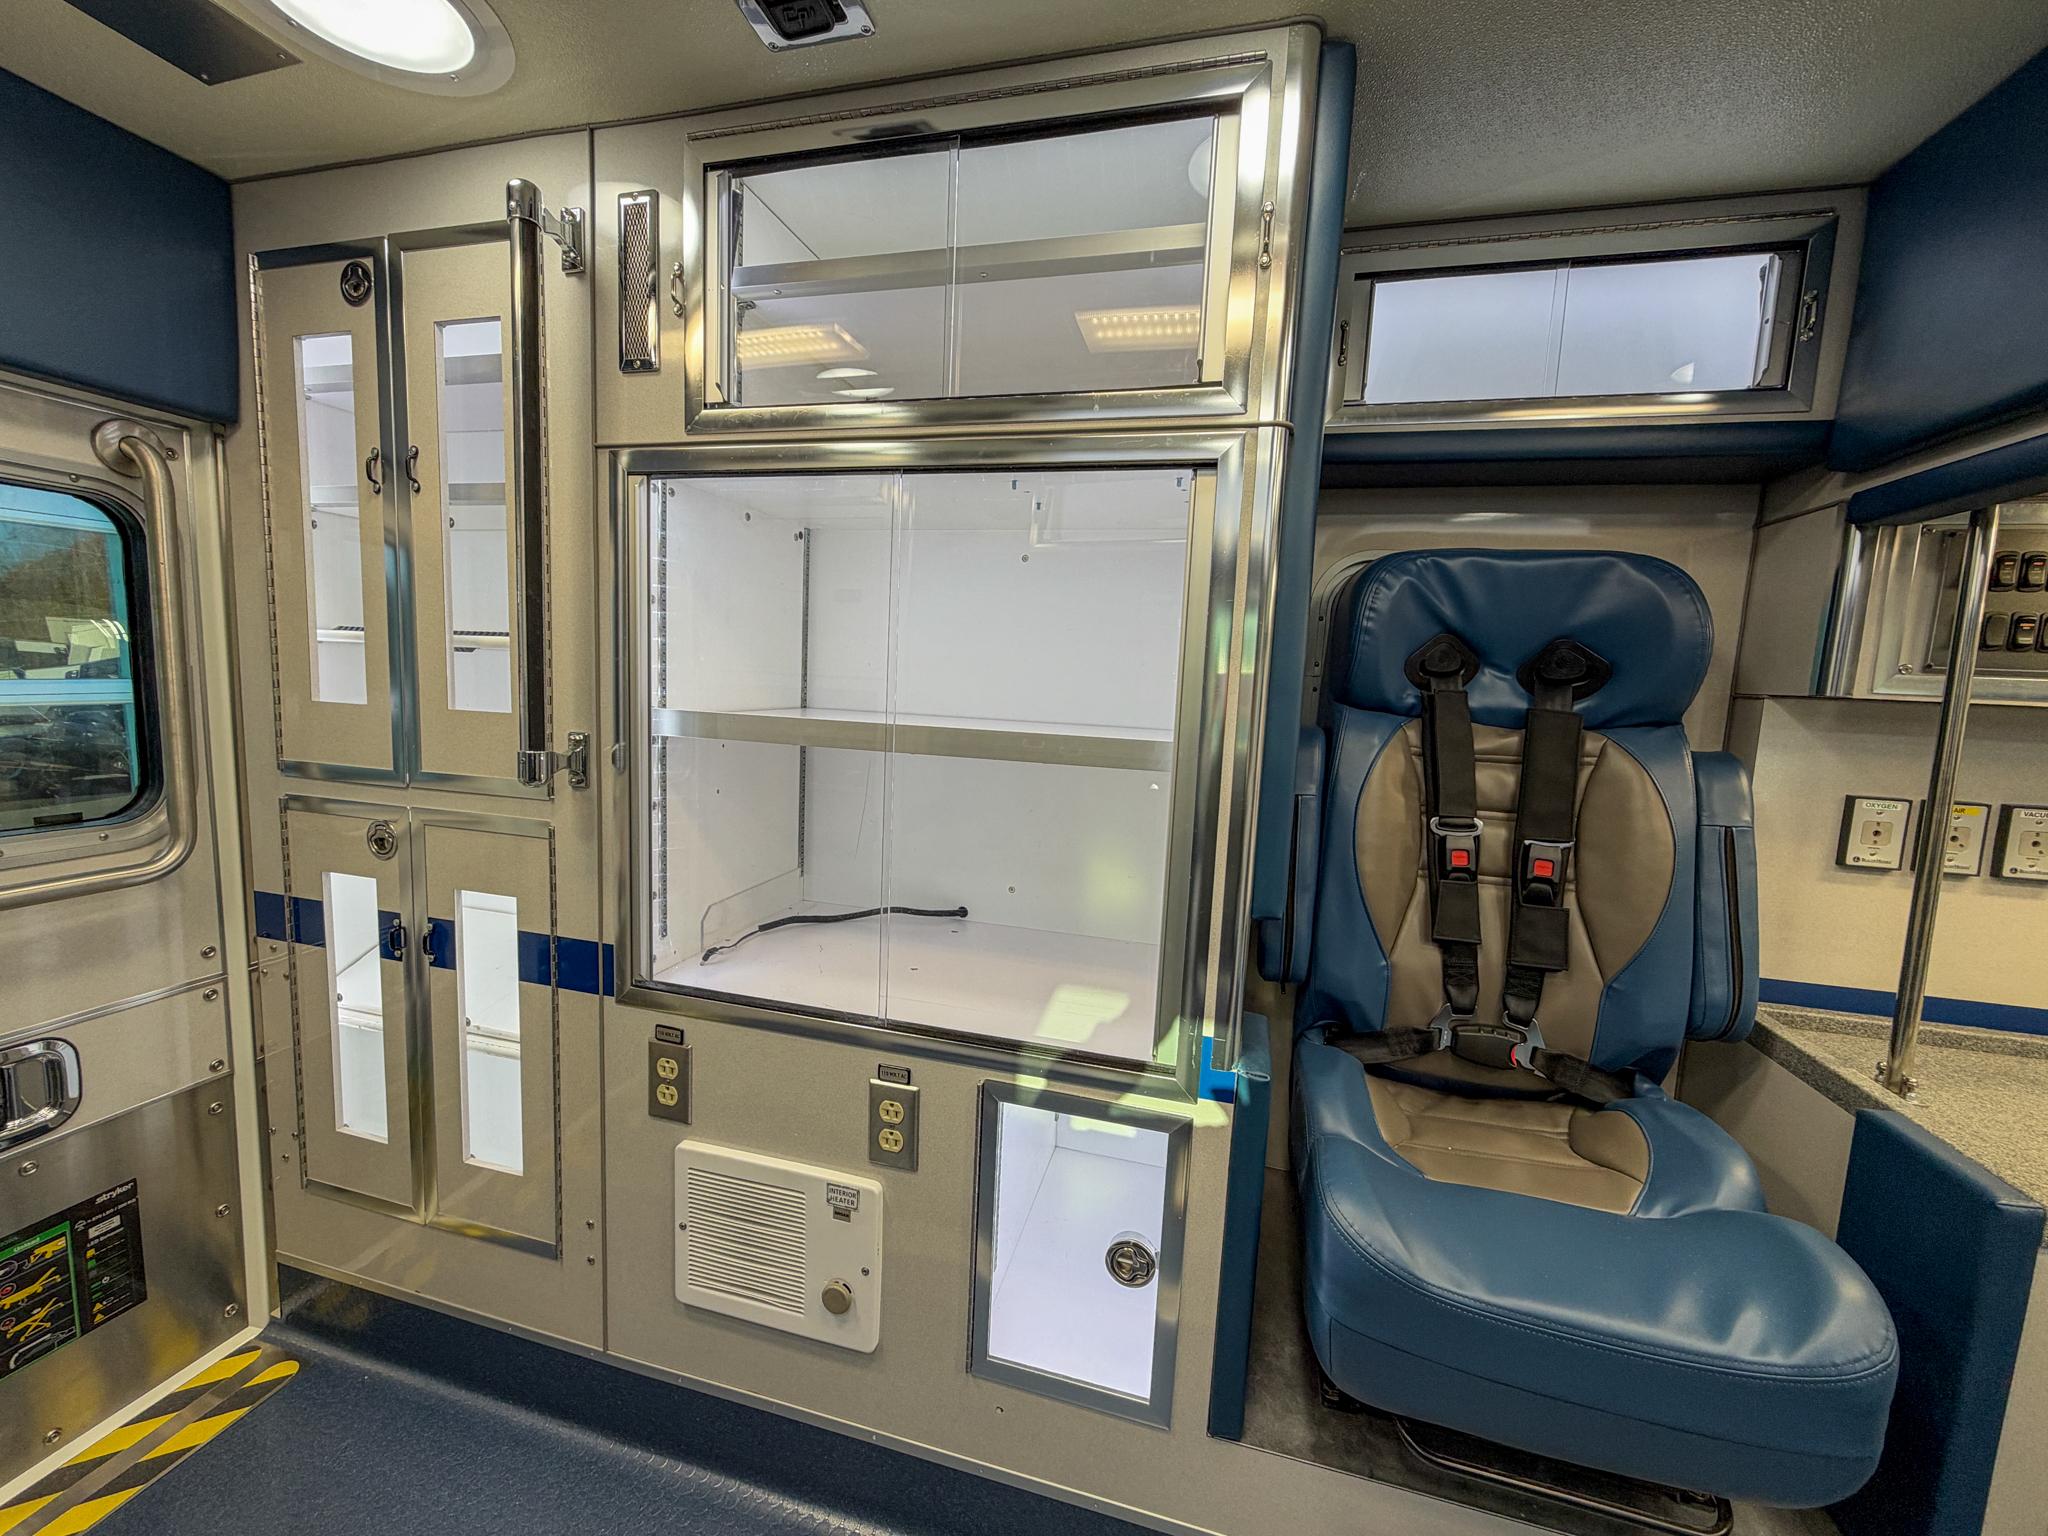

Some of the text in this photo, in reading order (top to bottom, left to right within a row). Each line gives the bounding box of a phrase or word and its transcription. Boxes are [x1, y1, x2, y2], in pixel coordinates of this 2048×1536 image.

[1865, 802, 1899, 810] OXYGEN
[95, 1182, 135, 1205] stryker
[828, 1187, 857, 1199] INTERIOR
[830, 1194, 856, 1207] HEATER
